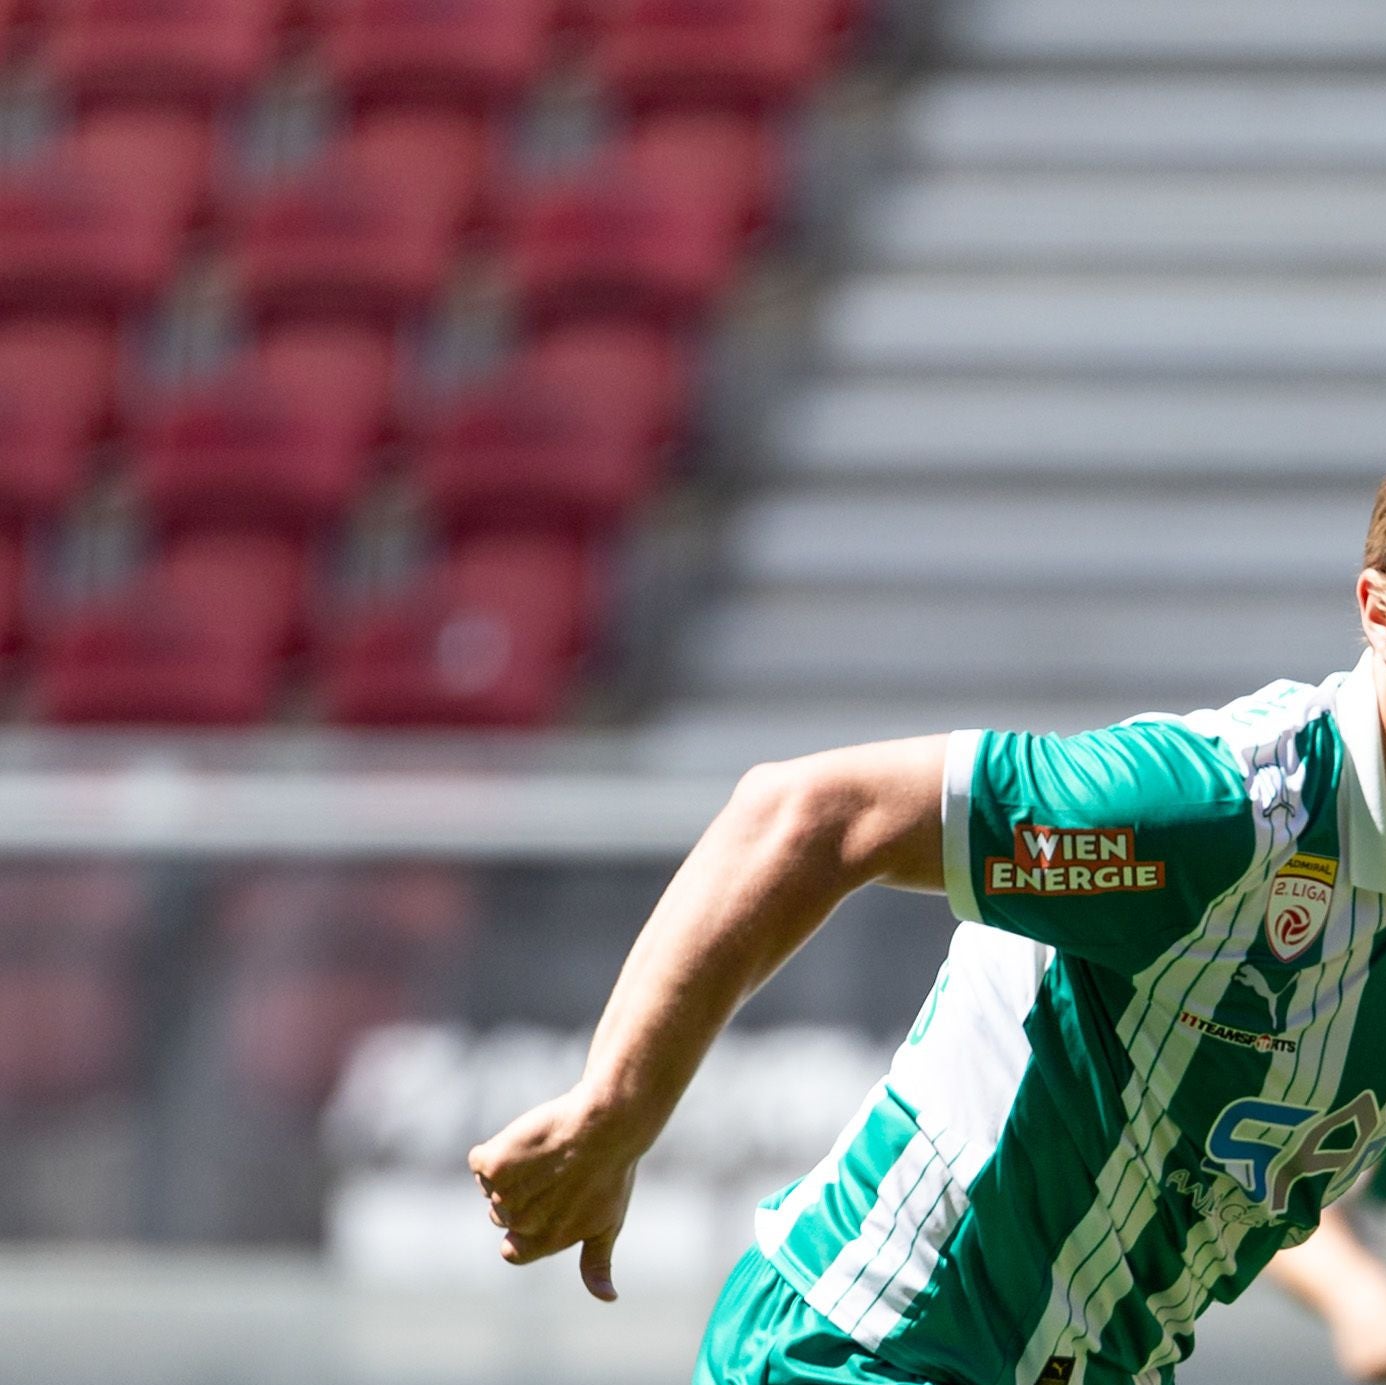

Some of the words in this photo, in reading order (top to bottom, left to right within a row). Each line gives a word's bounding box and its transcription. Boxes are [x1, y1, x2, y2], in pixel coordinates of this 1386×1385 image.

[1022, 830, 1128, 862] WIEN
[991, 862, 1159, 892] ENERGIE
[1291, 882, 1327, 905] LIGA
